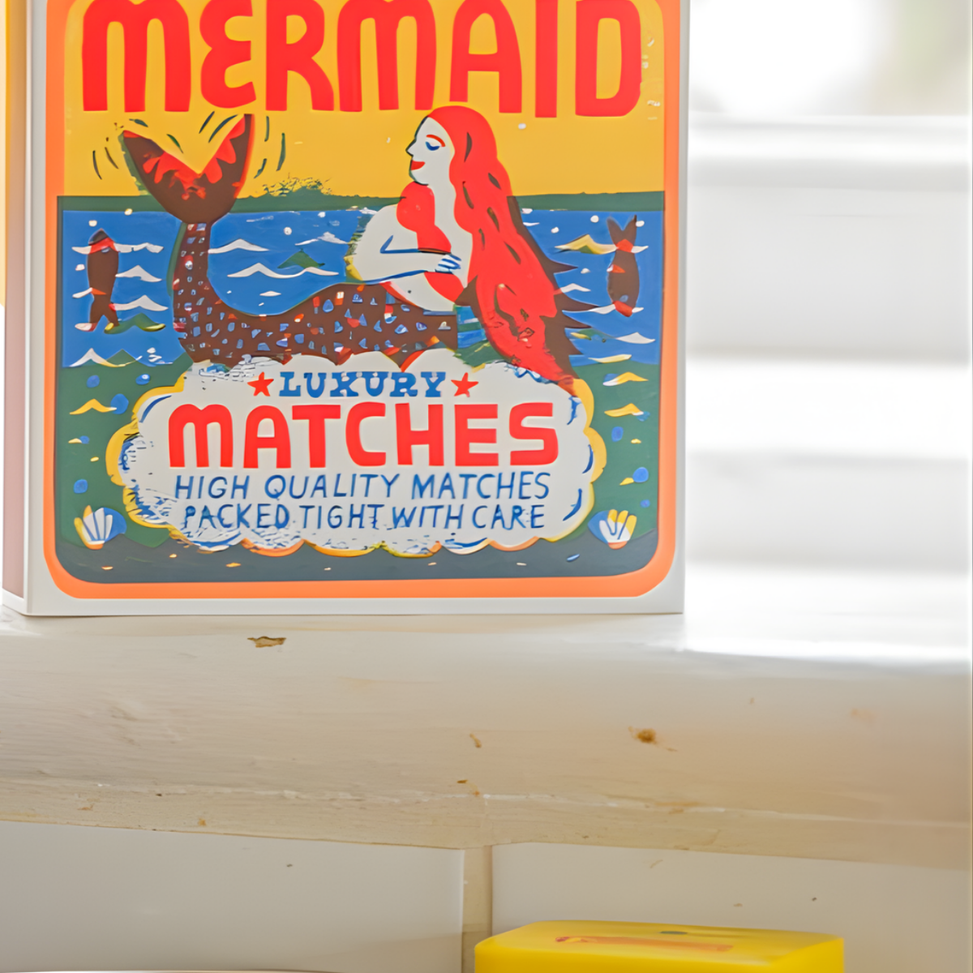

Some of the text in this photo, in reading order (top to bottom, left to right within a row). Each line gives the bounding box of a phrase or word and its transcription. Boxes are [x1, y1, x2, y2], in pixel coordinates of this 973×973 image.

[279, 371, 446, 398] LUXURY
[168, 401, 559, 469] MATCHES
[175, 470, 551, 500] HIGH QUALITY MATCHES
[183, 503, 545, 530] PACKED TIGHT WITH CARE
